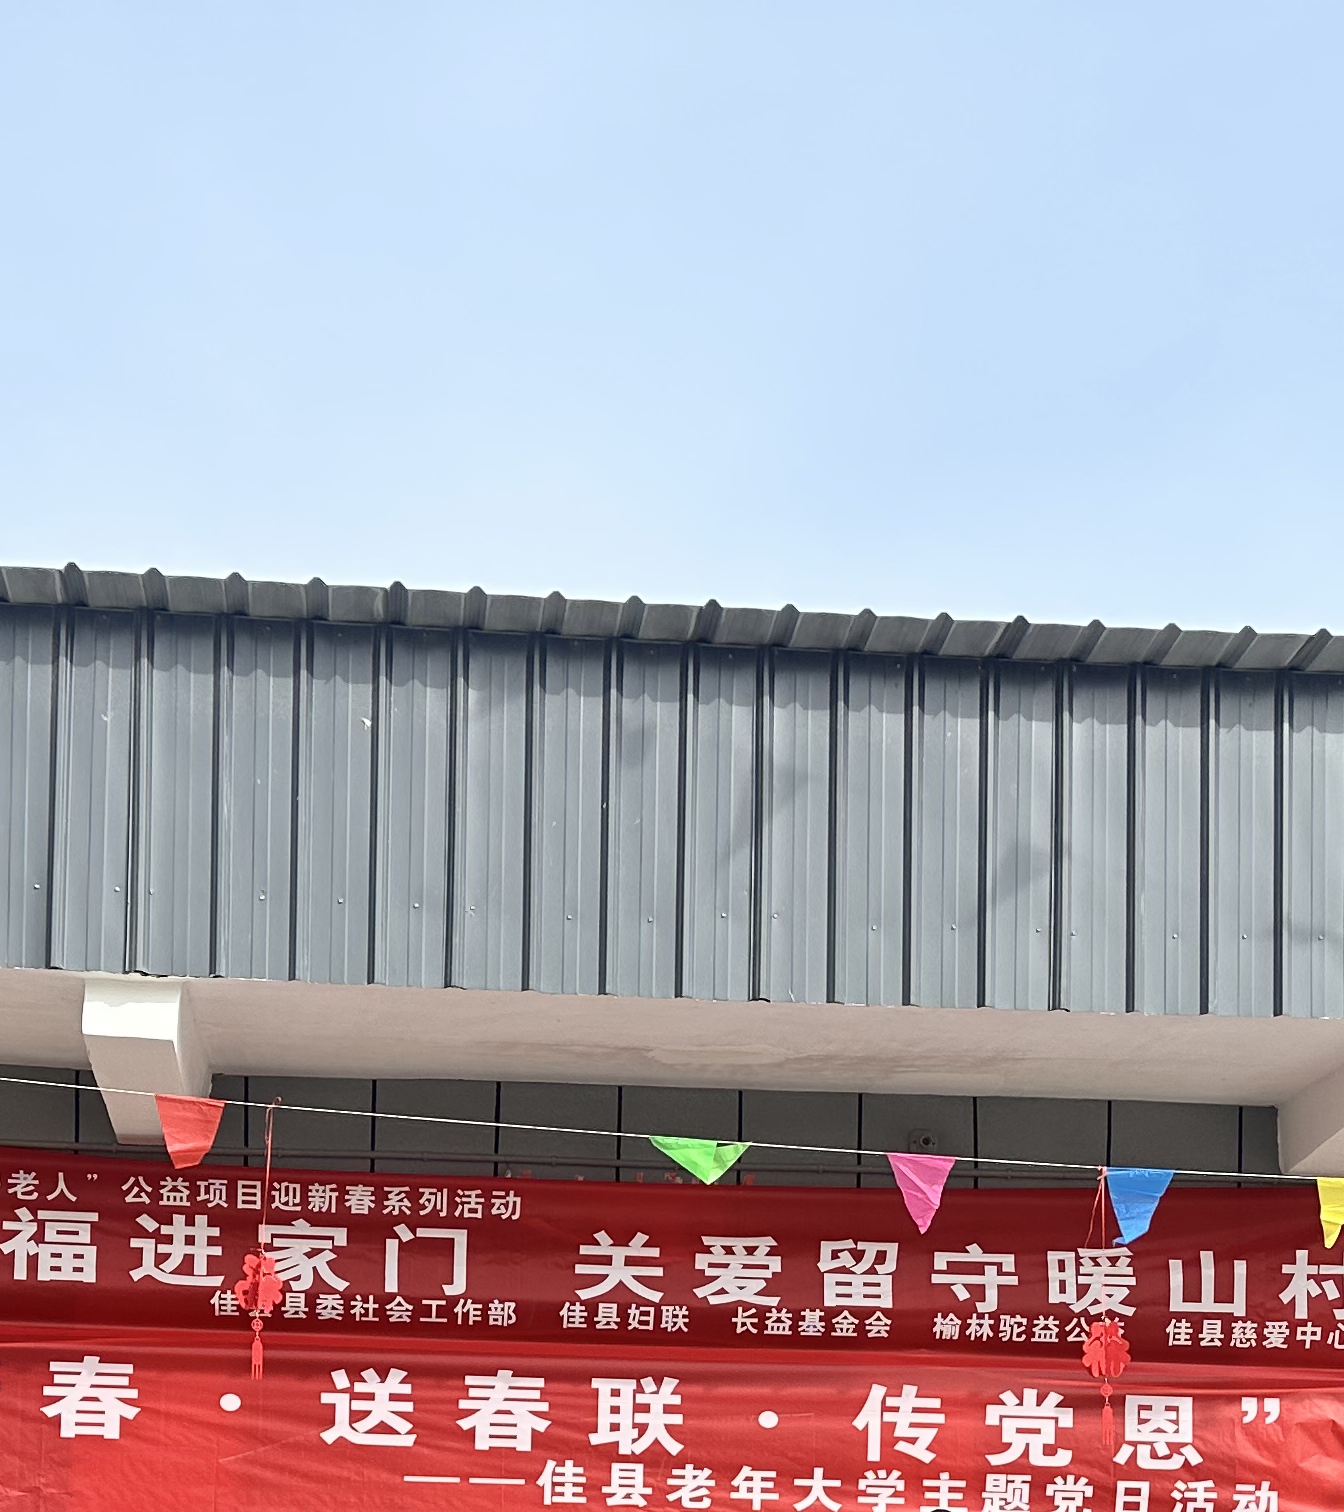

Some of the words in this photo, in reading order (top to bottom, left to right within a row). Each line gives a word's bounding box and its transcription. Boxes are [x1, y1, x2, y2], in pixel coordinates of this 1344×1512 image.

[210, 1290, 517, 1328] 佳县委社会工作部
[560, 1302, 689, 1333] 佳县妇联
[732, 1307, 893, 1339] 长益基金会
[933, 1313, 1124, 1343] 榆林驼益公
